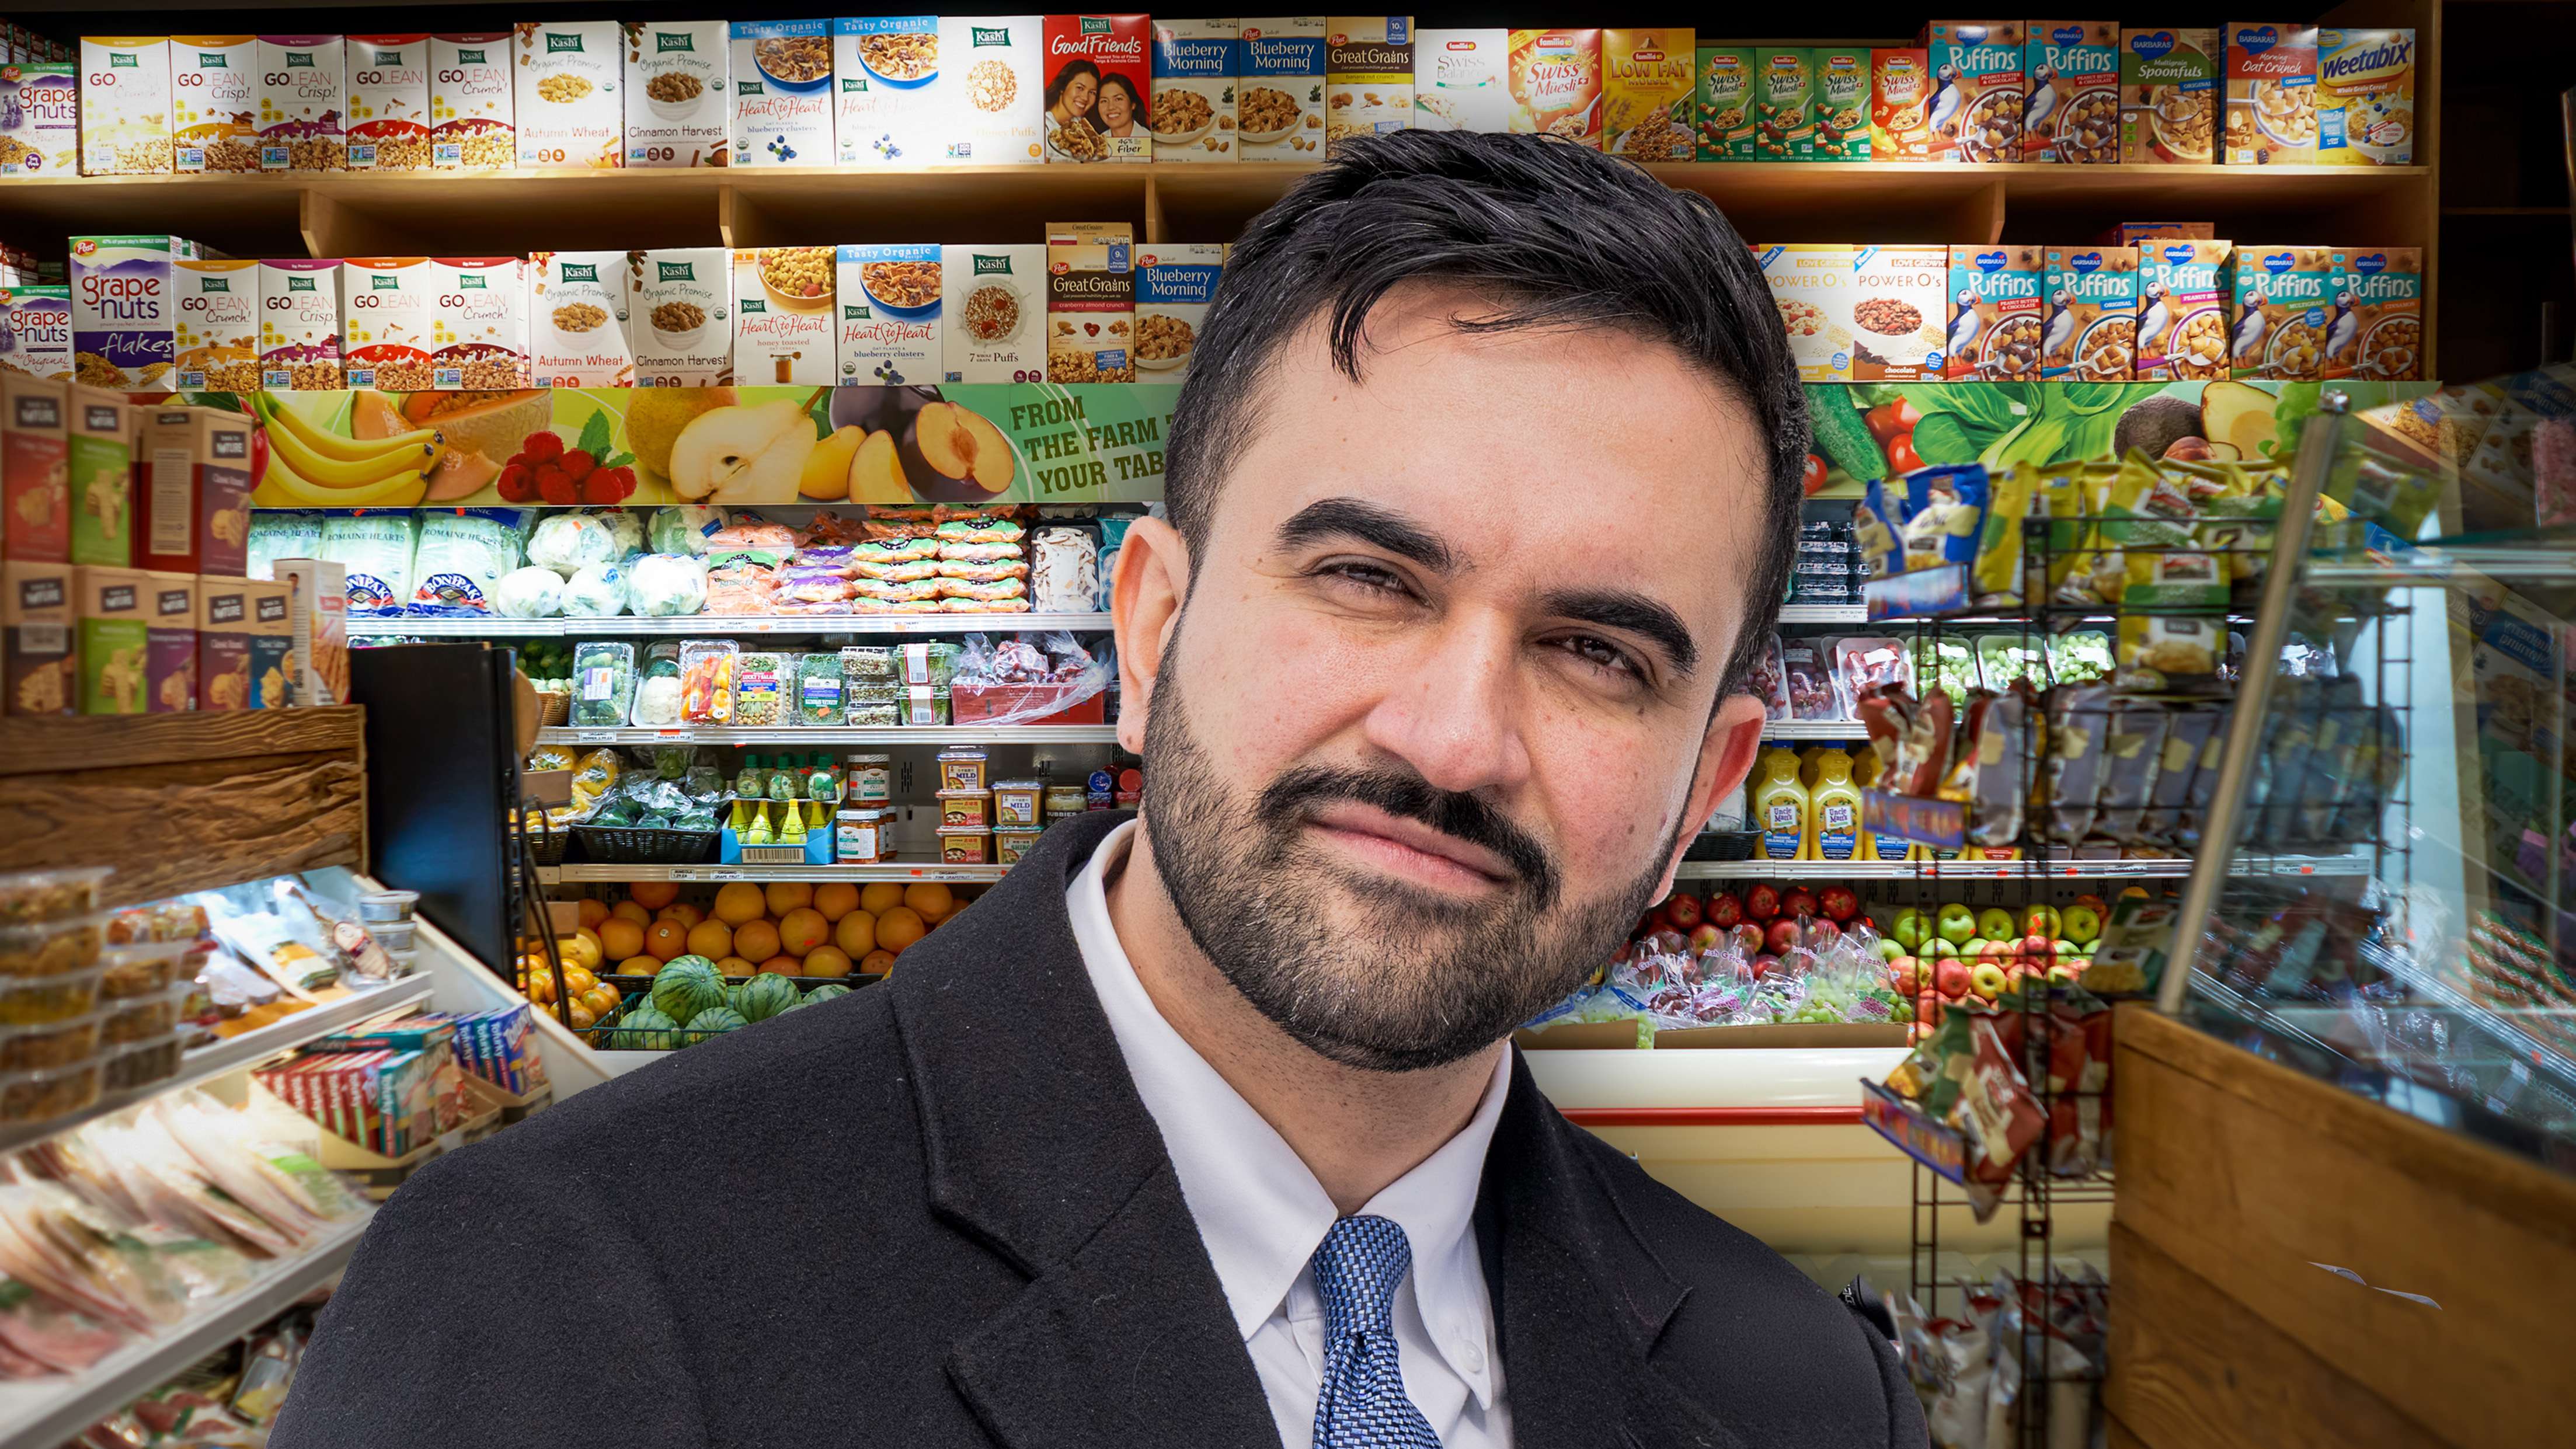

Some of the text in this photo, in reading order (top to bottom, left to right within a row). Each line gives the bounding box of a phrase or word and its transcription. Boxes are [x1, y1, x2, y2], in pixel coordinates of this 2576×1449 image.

[844, 19, 928, 32] Tasty Organic
[550, 37, 578, 47] Kashi
[660, 36, 688, 47] Kashi
[1164, 43, 1227, 58] Blueberry
[1251, 41, 1315, 58] Blueberry
[640, 54, 712, 73] Organic Promise
[1168, 57, 1223, 72] Morning
[1255, 55, 1311, 71] Morning
[1610, 59, 1689, 79] LOW FAT
[2154, 59, 2188, 68] Multigrain
[2241, 61, 2302, 74] Oat Crunch
[1527, 61, 1580, 84] Swiss
[1708, 72, 1740, 86] Swiss
[1767, 72, 1800, 86] Swiss
[2138, 64, 2202, 79] Spoonfuls
[462, 80, 507, 95] Crunch!
[2182, 81, 2212, 89] ORIGINAL
[2285, 76, 2312, 85] ORIGINAL
[20, 86, 78, 109] grape
[211, 87, 250, 102] Crisp!
[298, 86, 336, 102] Crisp!
[524, 127, 610, 138] Autumn Wheat
[629, 125, 722, 137] Cinnamon Harvest
[1011, 127, 1036, 137] Puffs
[77, 242, 95, 253] Post
[847, 246, 931, 259] Tasty Organic
[1141, 255, 1156, 266] Post
[1760, 246, 1782, 266] New!
[1893, 259, 1946, 267] LOVE GROWN
[977, 259, 1007, 270] Kashi
[1053, 264, 1068, 273] Post
[1147, 268, 1211, 284] Blueberry
[1858, 275, 1913, 287] POWER
[82, 274, 161, 305] grape
[1151, 282, 1206, 298] Morning
[1968, 271, 2037, 297] Puffins
[2063, 273, 2131, 297] Puffins
[2255, 271, 2323, 297] Puffins
[2347, 273, 2415, 298] Puffins
[545, 284, 616, 303] Organic Promise
[643, 283, 713, 302] Organic Promise
[91, 297, 160, 319] -nuts
[463, 305, 508, 320] Crunch!
[2384, 301, 2415, 310] CINNAMON
[11, 309, 69, 333] grape
[206, 309, 251, 323] Crunch!
[300, 309, 339, 326] Crisp!
[17, 325, 68, 343] -nuts
[739, 316, 829, 337] Heart to Heart
[844, 322, 935, 344] Heart to Heart
[99, 332, 175, 358] flakes
[757, 339, 781, 349] honey
[538, 354, 624, 367] Autumn Wheat
[636, 354, 727, 367] Cinnamon Harvest
[854, 350, 891, 358] blueberry
[969, 352, 975, 363] 7
[993, 352, 1019, 363] Puffs
[23, 354, 70, 371] Original
[1010, 395, 1086, 431] FROM
[1024, 416, 1160, 462] THE FARM
[1036, 450, 1165, 494] YOUR TAB
[291, 530, 322, 538] HEART
[327, 532, 405, 542] ROMAINE HEARTS
[424, 528, 465, 539] ROMAINE
[346, 574, 393, 598] ONIPAK
[426, 573, 483, 601] BONIPAK
[1774, 807, 1792, 815] Uncle
[1829, 807, 1847, 816] Uncle
